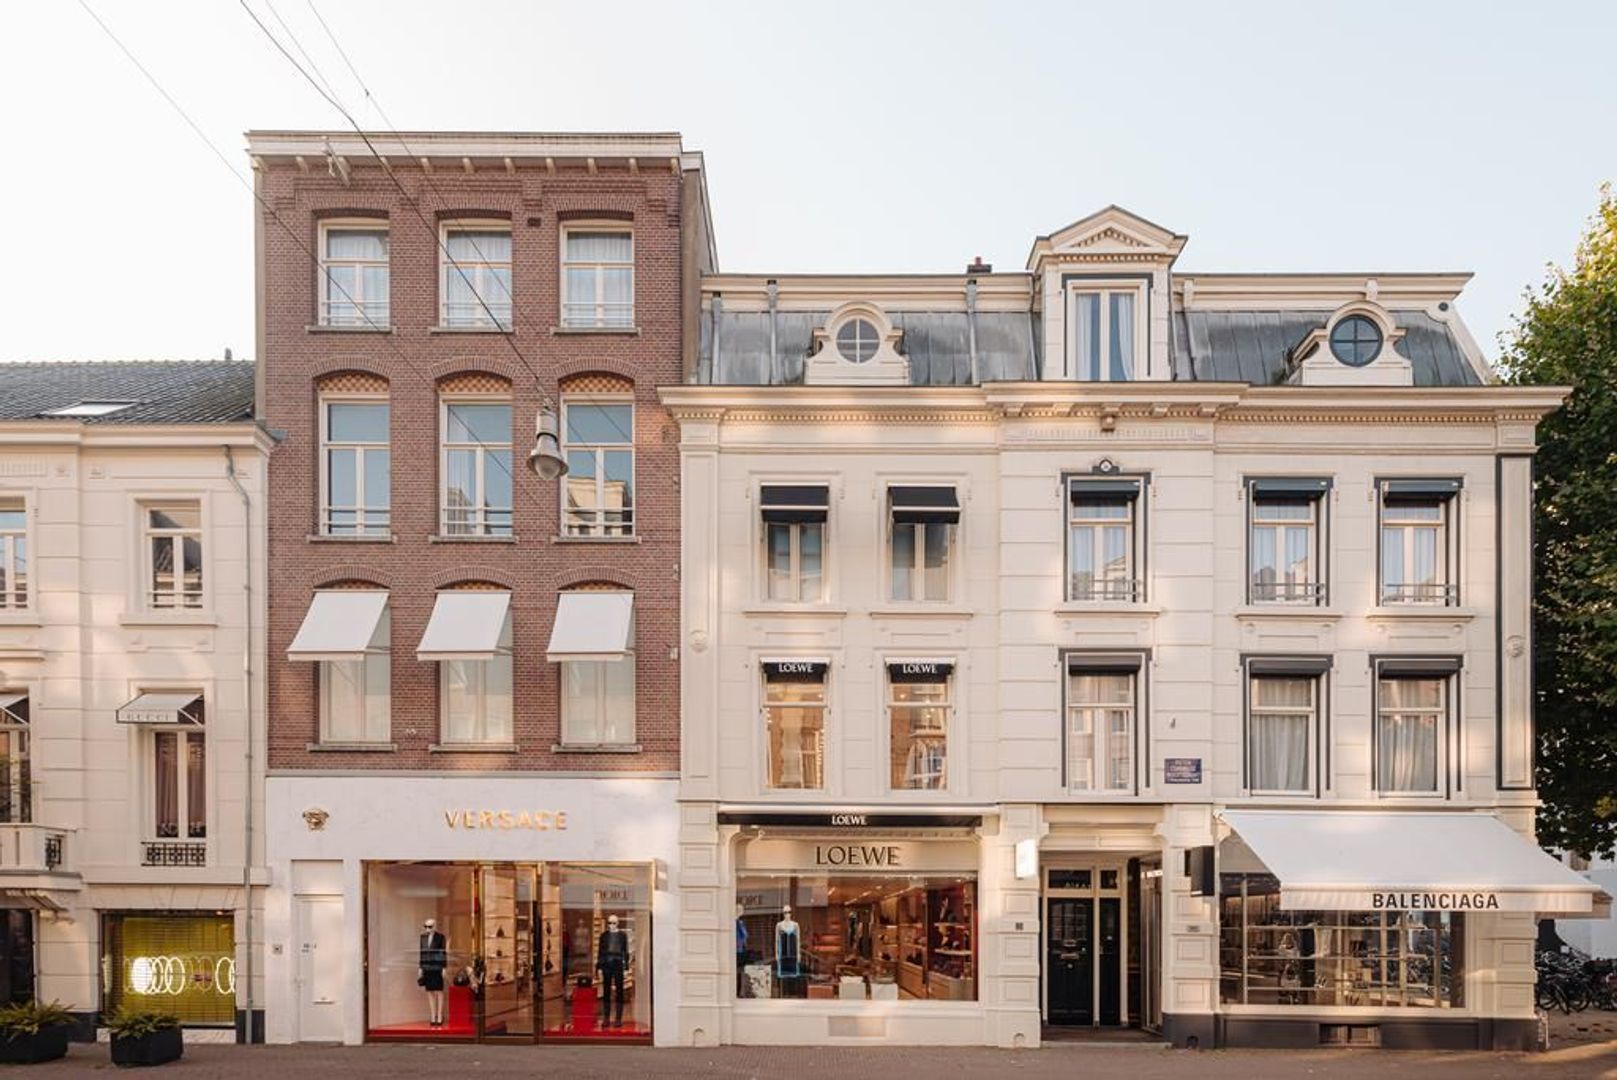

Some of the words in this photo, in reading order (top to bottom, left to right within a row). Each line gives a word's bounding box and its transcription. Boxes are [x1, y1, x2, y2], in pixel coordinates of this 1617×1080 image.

[778, 662, 814, 673] LOEWE
[902, 663, 938, 674] LOEWE
[444, 809, 568, 830] VERSACE
[832, 815, 867, 826] LOEWE
[816, 846, 901, 866] LOEWE
[1372, 893, 1499, 909] BALENCIAGA
